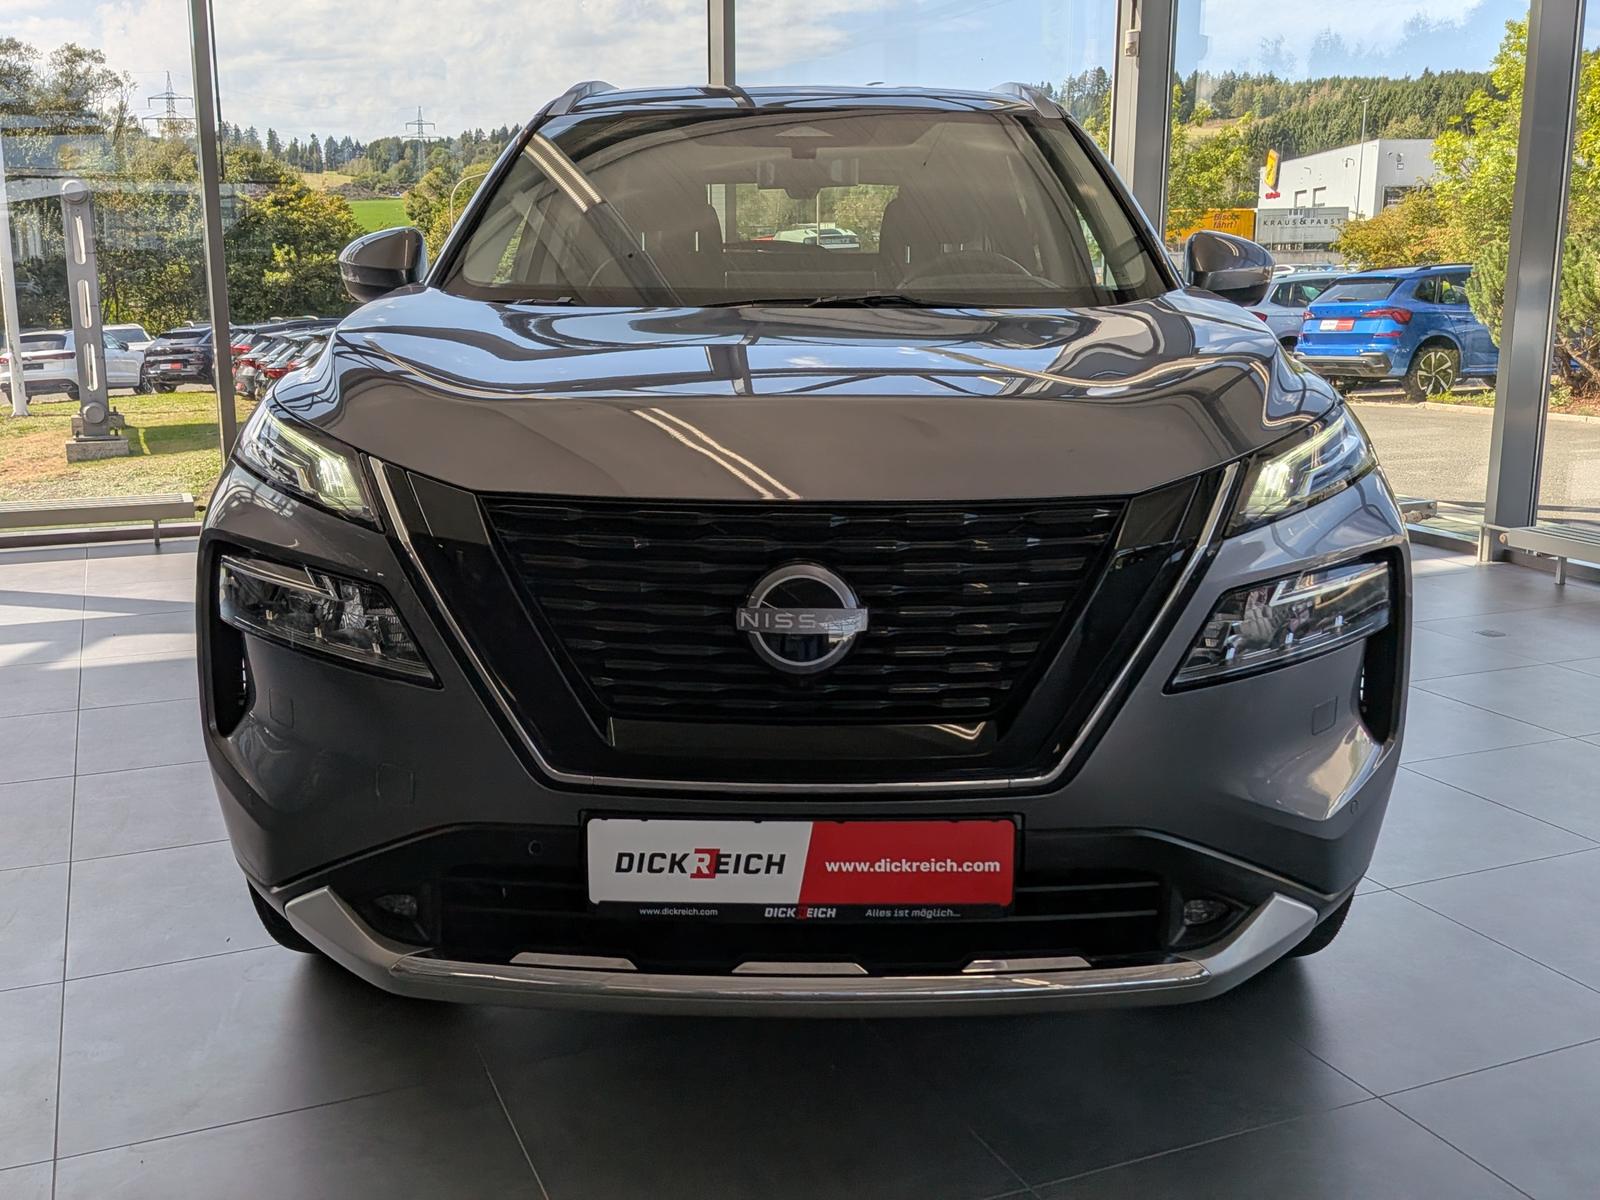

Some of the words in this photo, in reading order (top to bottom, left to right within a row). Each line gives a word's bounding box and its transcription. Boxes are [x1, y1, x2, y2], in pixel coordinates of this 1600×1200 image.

[1299, 217, 1307, 226] &
[1309, 217, 1342, 225] PABST
[740, 611, 863, 628] NISS
[615, 850, 786, 877] DICKREICH
[825, 858, 1001, 873] www.dickreich.com
[639, 907, 718, 916] www.dickreich.com
[865, 908, 892, 918] Alles
[894, 908, 909, 918] ist
